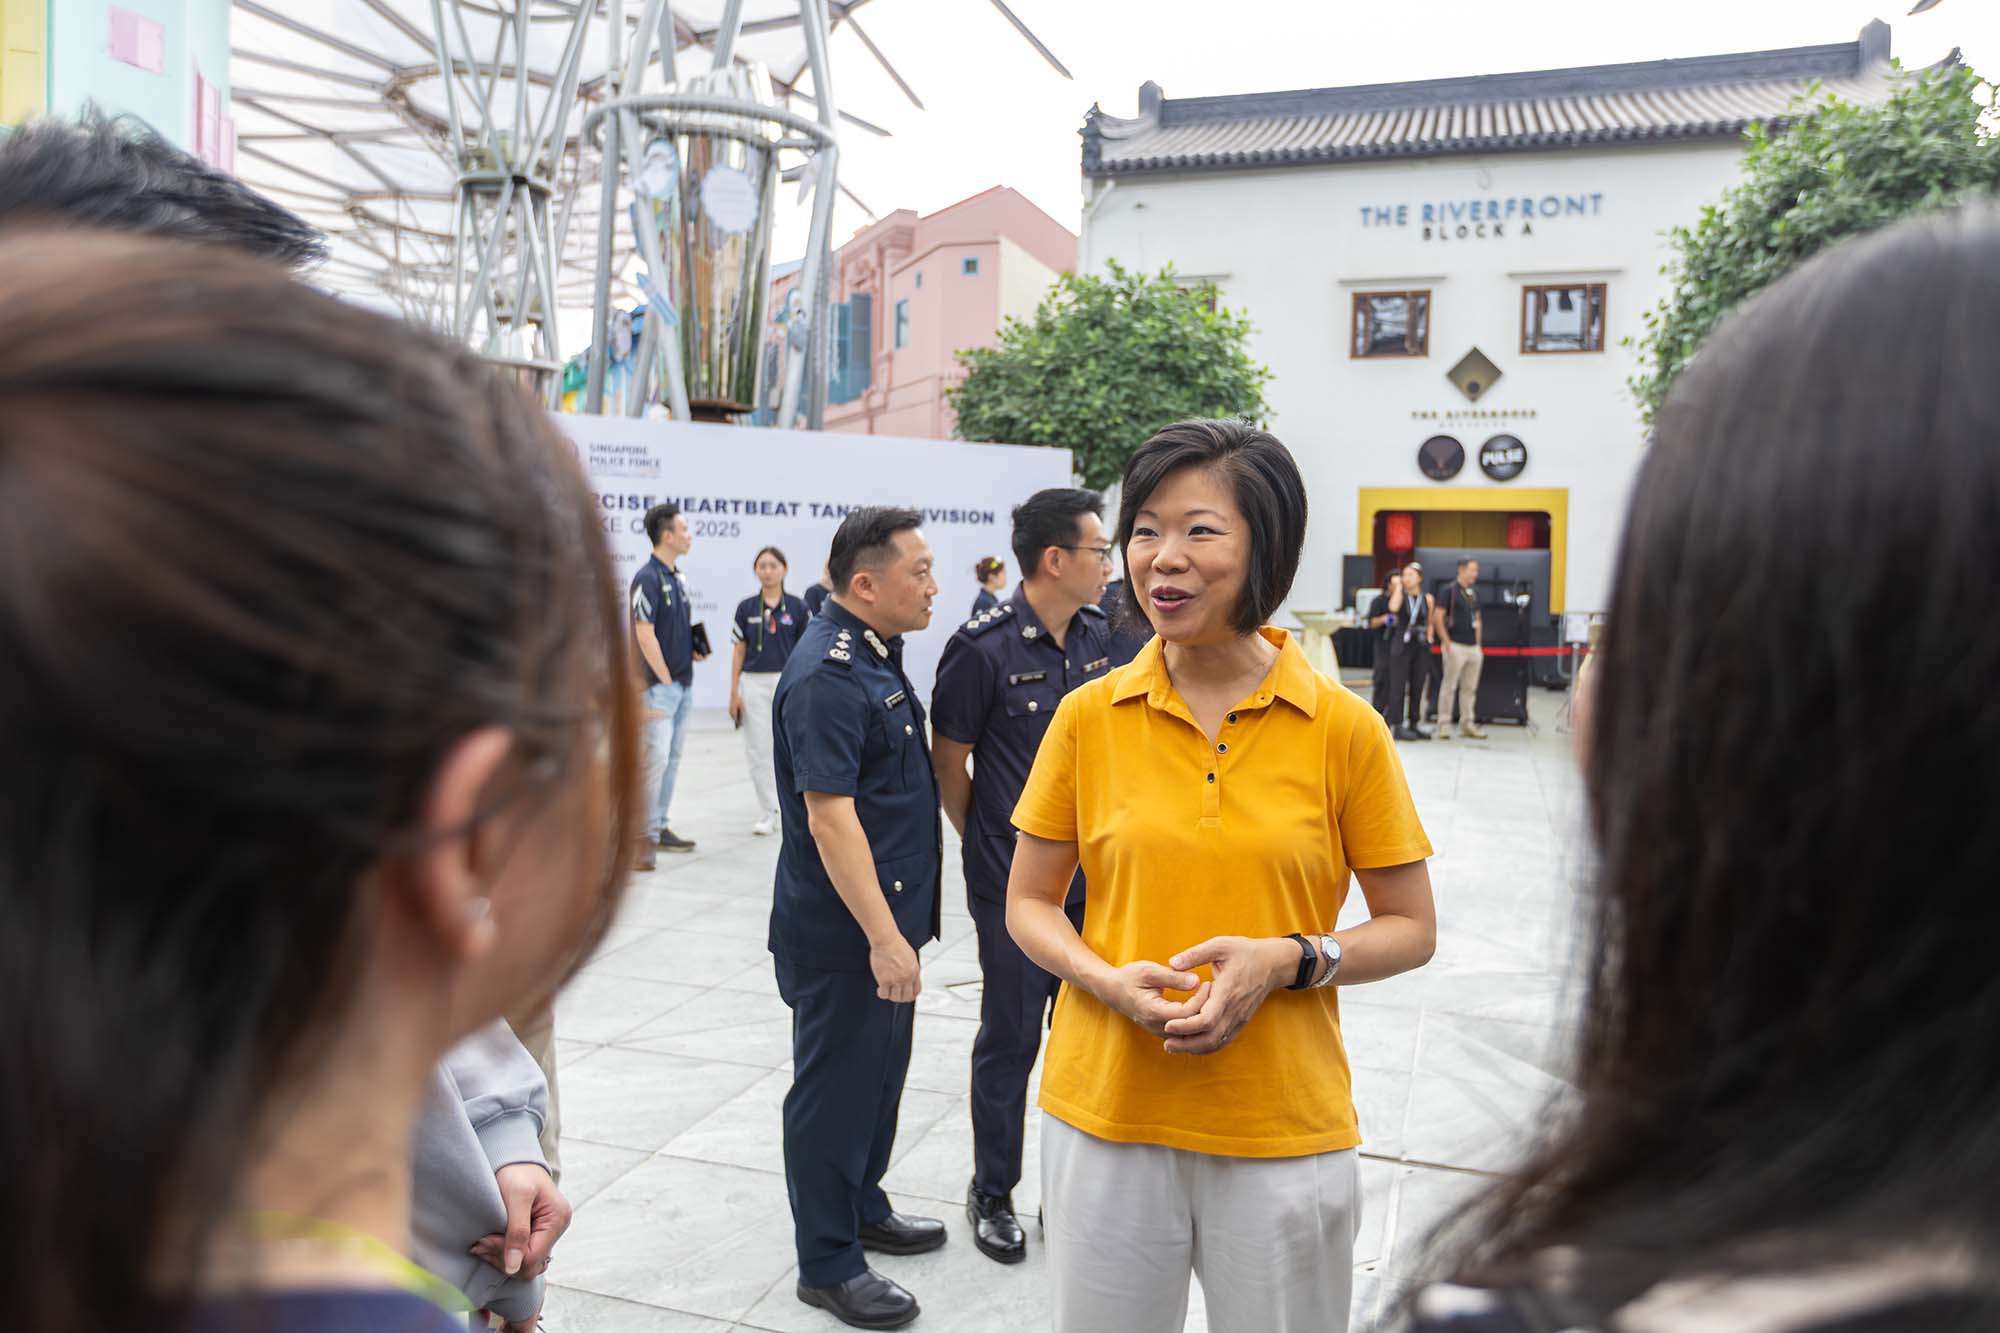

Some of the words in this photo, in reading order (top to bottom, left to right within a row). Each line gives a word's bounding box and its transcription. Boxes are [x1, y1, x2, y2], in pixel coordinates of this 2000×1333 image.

[1361, 205, 1408, 226] THE
[1422, 193, 1603, 224] RIVERFRONT
[1422, 224, 1503, 240] BLOCK
[1522, 223, 1533, 236] A
[590, 443, 648, 456] SINGAPORE
[590, 455, 624, 468] POLICE
[629, 457, 662, 469] FORCE
[666, 496, 800, 517] HEARTBEAT
[920, 507, 995, 525] IVISION
[695, 520, 741, 538] 2025
